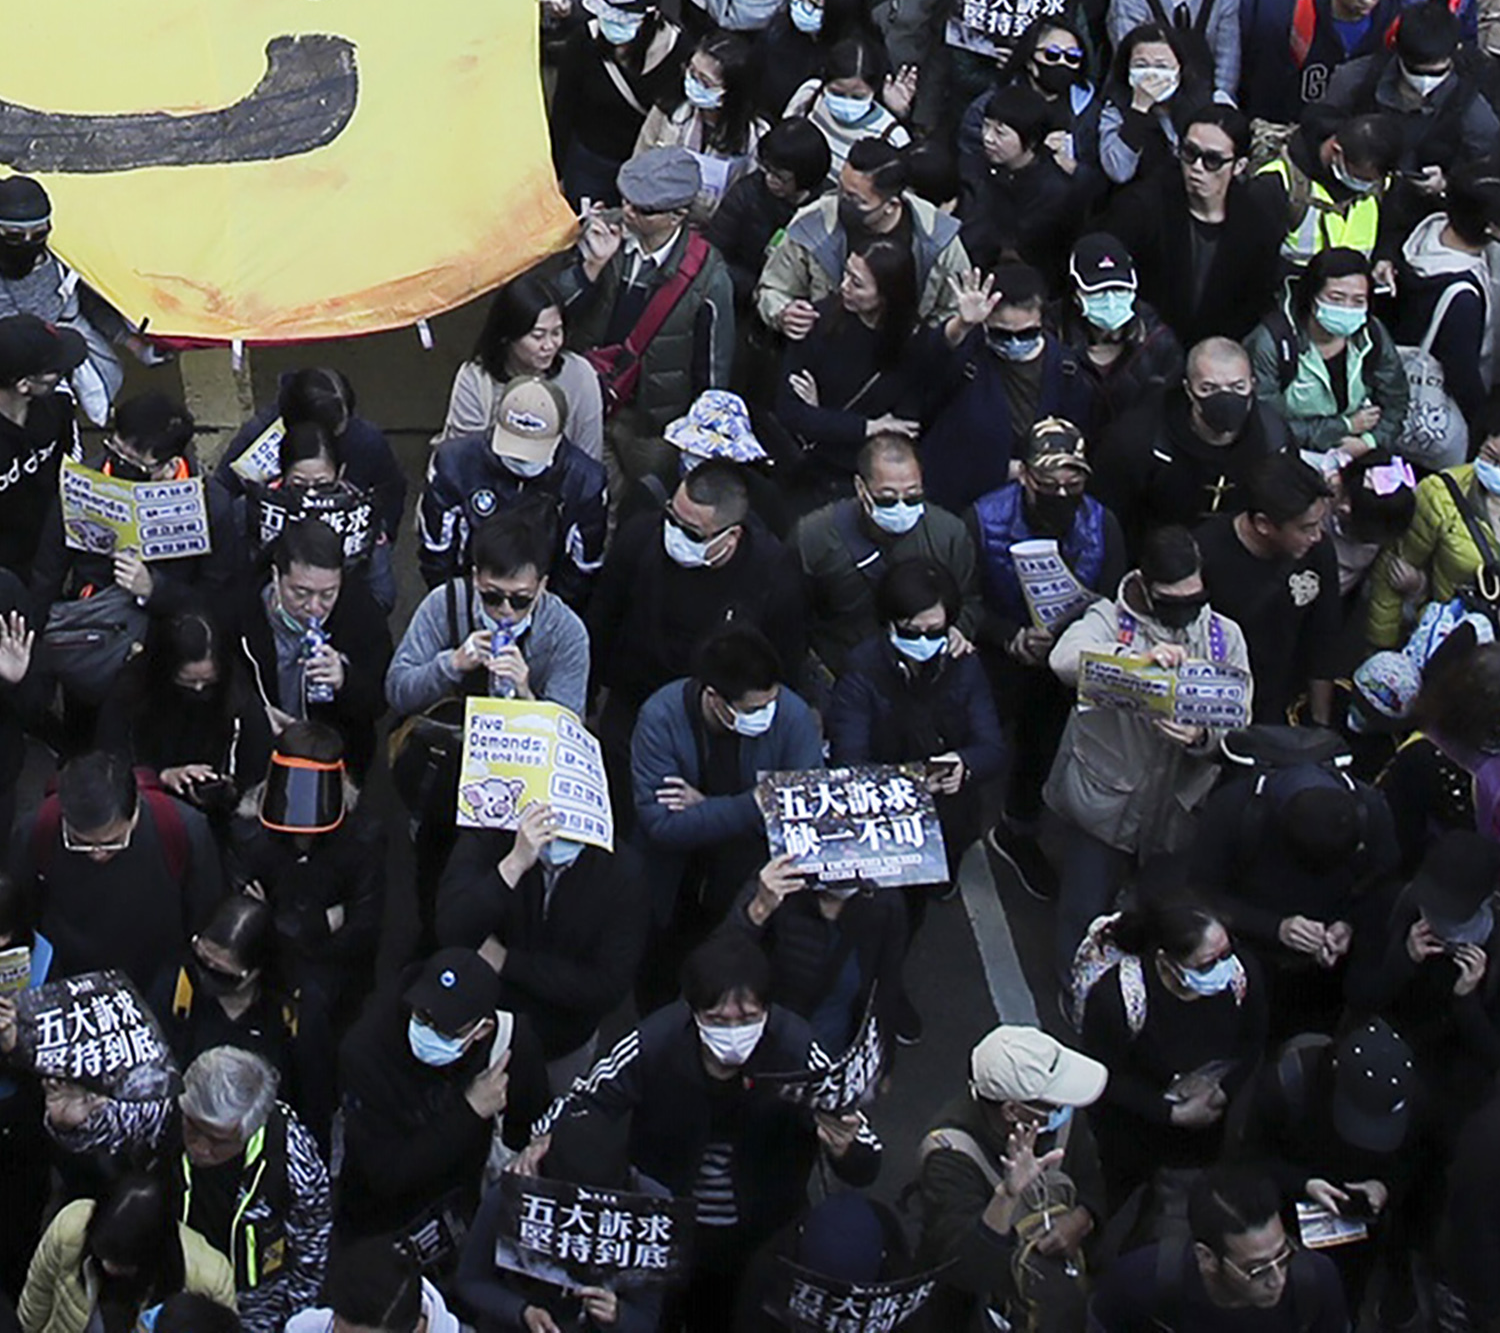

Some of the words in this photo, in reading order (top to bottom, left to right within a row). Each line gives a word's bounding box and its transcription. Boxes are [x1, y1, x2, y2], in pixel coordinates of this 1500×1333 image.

[470, 715, 504, 730] Five
[775, 777, 919, 821] 五大訴求
[782, 812, 925, 857] 缺一不可
[35, 987, 144, 1050] 五大訴求
[38, 1027, 161, 1074] 堅持到底
[522, 1194, 674, 1245] 五大訴求
[520, 1219, 671, 1269] 堅持到底
[794, 1280, 937, 1317] 五大訴求
